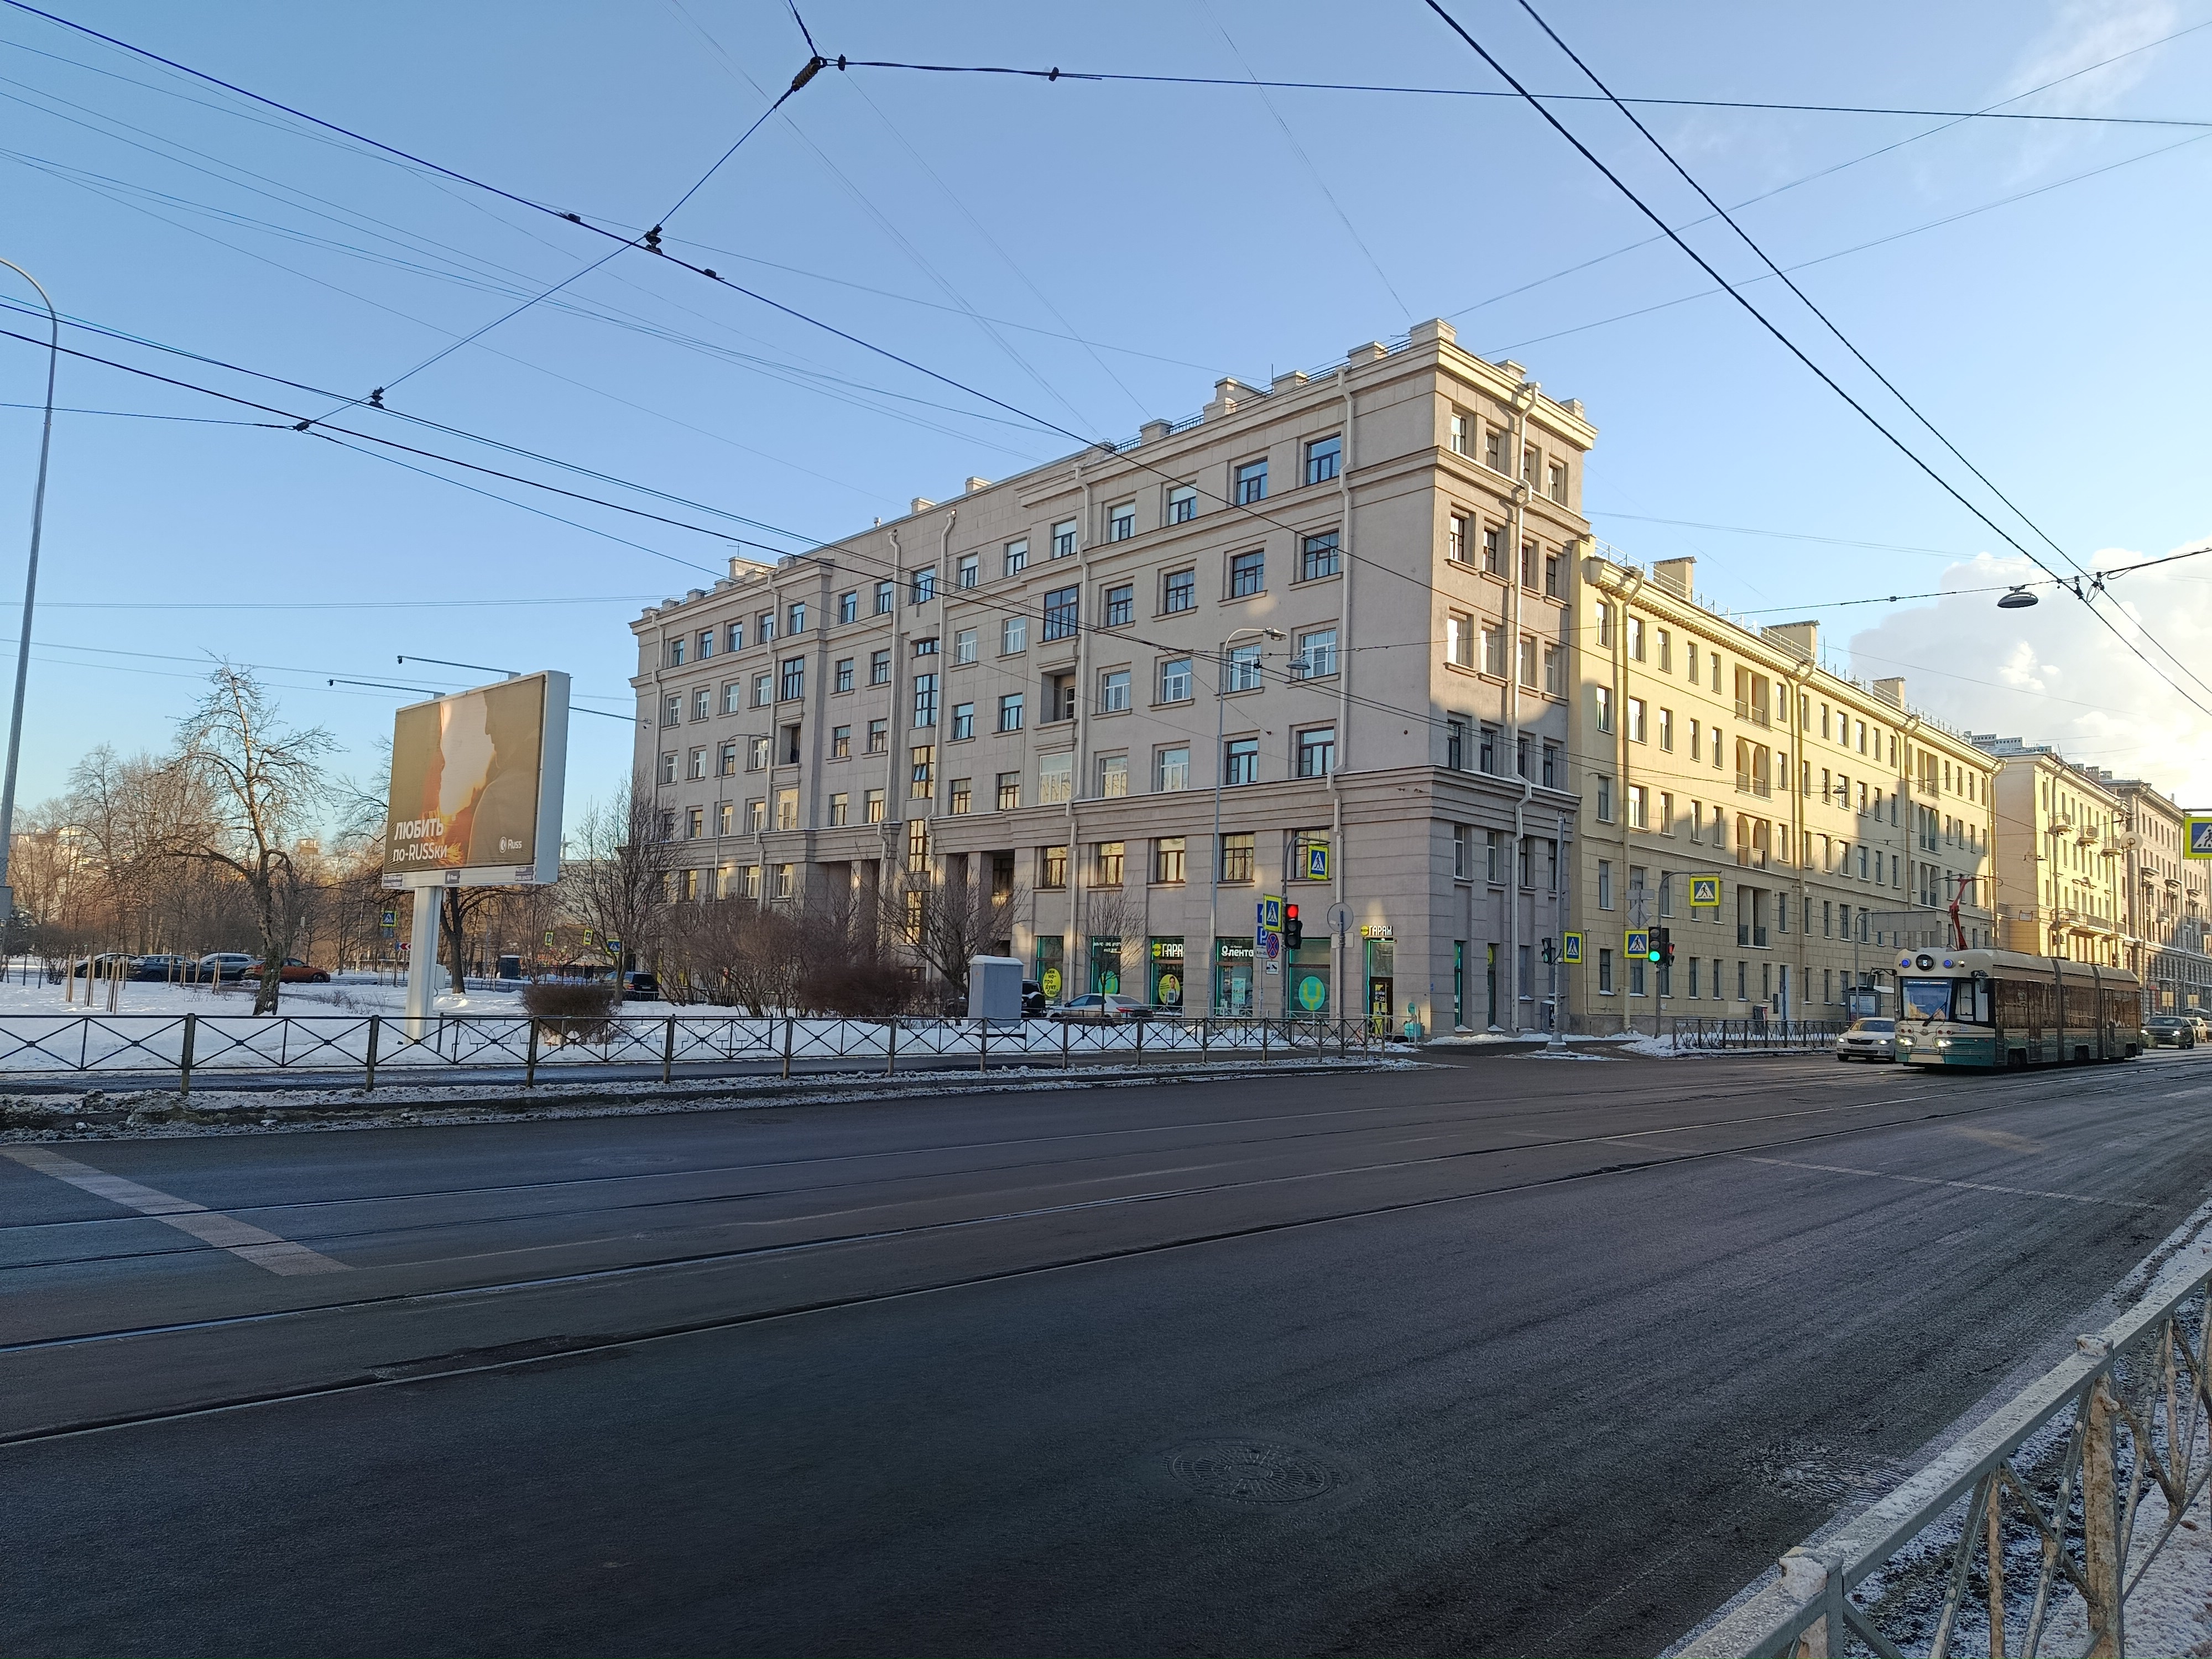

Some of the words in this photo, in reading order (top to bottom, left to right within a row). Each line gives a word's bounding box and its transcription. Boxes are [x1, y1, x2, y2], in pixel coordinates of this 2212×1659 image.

[394, 818, 444, 840] ЛЮБИТЬ
[393, 842, 447, 862] по-RUSSки
[1369, 925, 1393, 936] ГАРАЖ
[1162, 943, 1183, 957] ГАРА
